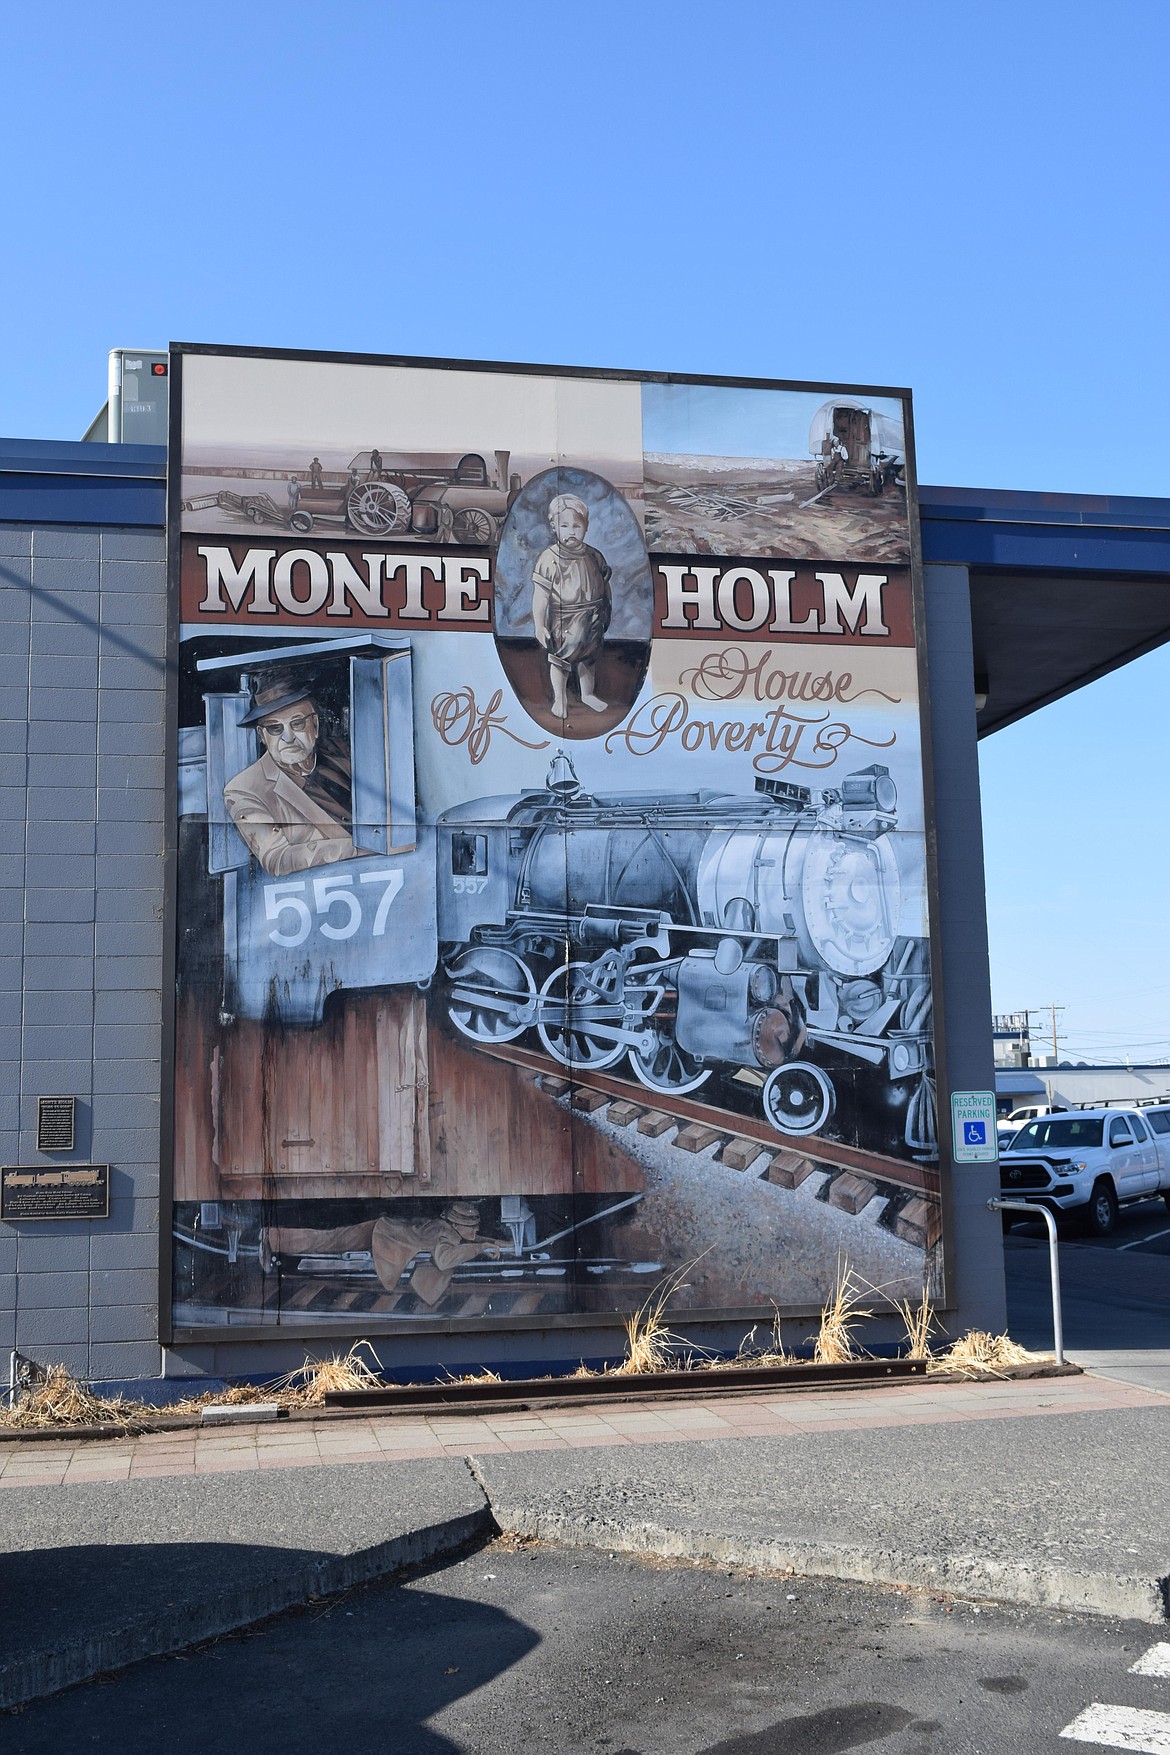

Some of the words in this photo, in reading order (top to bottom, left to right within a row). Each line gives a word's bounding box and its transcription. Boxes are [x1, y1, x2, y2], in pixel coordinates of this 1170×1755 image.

[198, 546, 491, 621] MONTE
[658, 564, 889, 636] HOLM
[679, 647, 901, 703] House
[430, 686, 550, 765] Of
[606, 692, 896, 773] Poverty
[263, 869, 405, 948] 557
[453, 878, 488, 894] 557
[954, 1097, 992, 1107] RESERVED
[958, 1110, 990, 1119] PARKING
